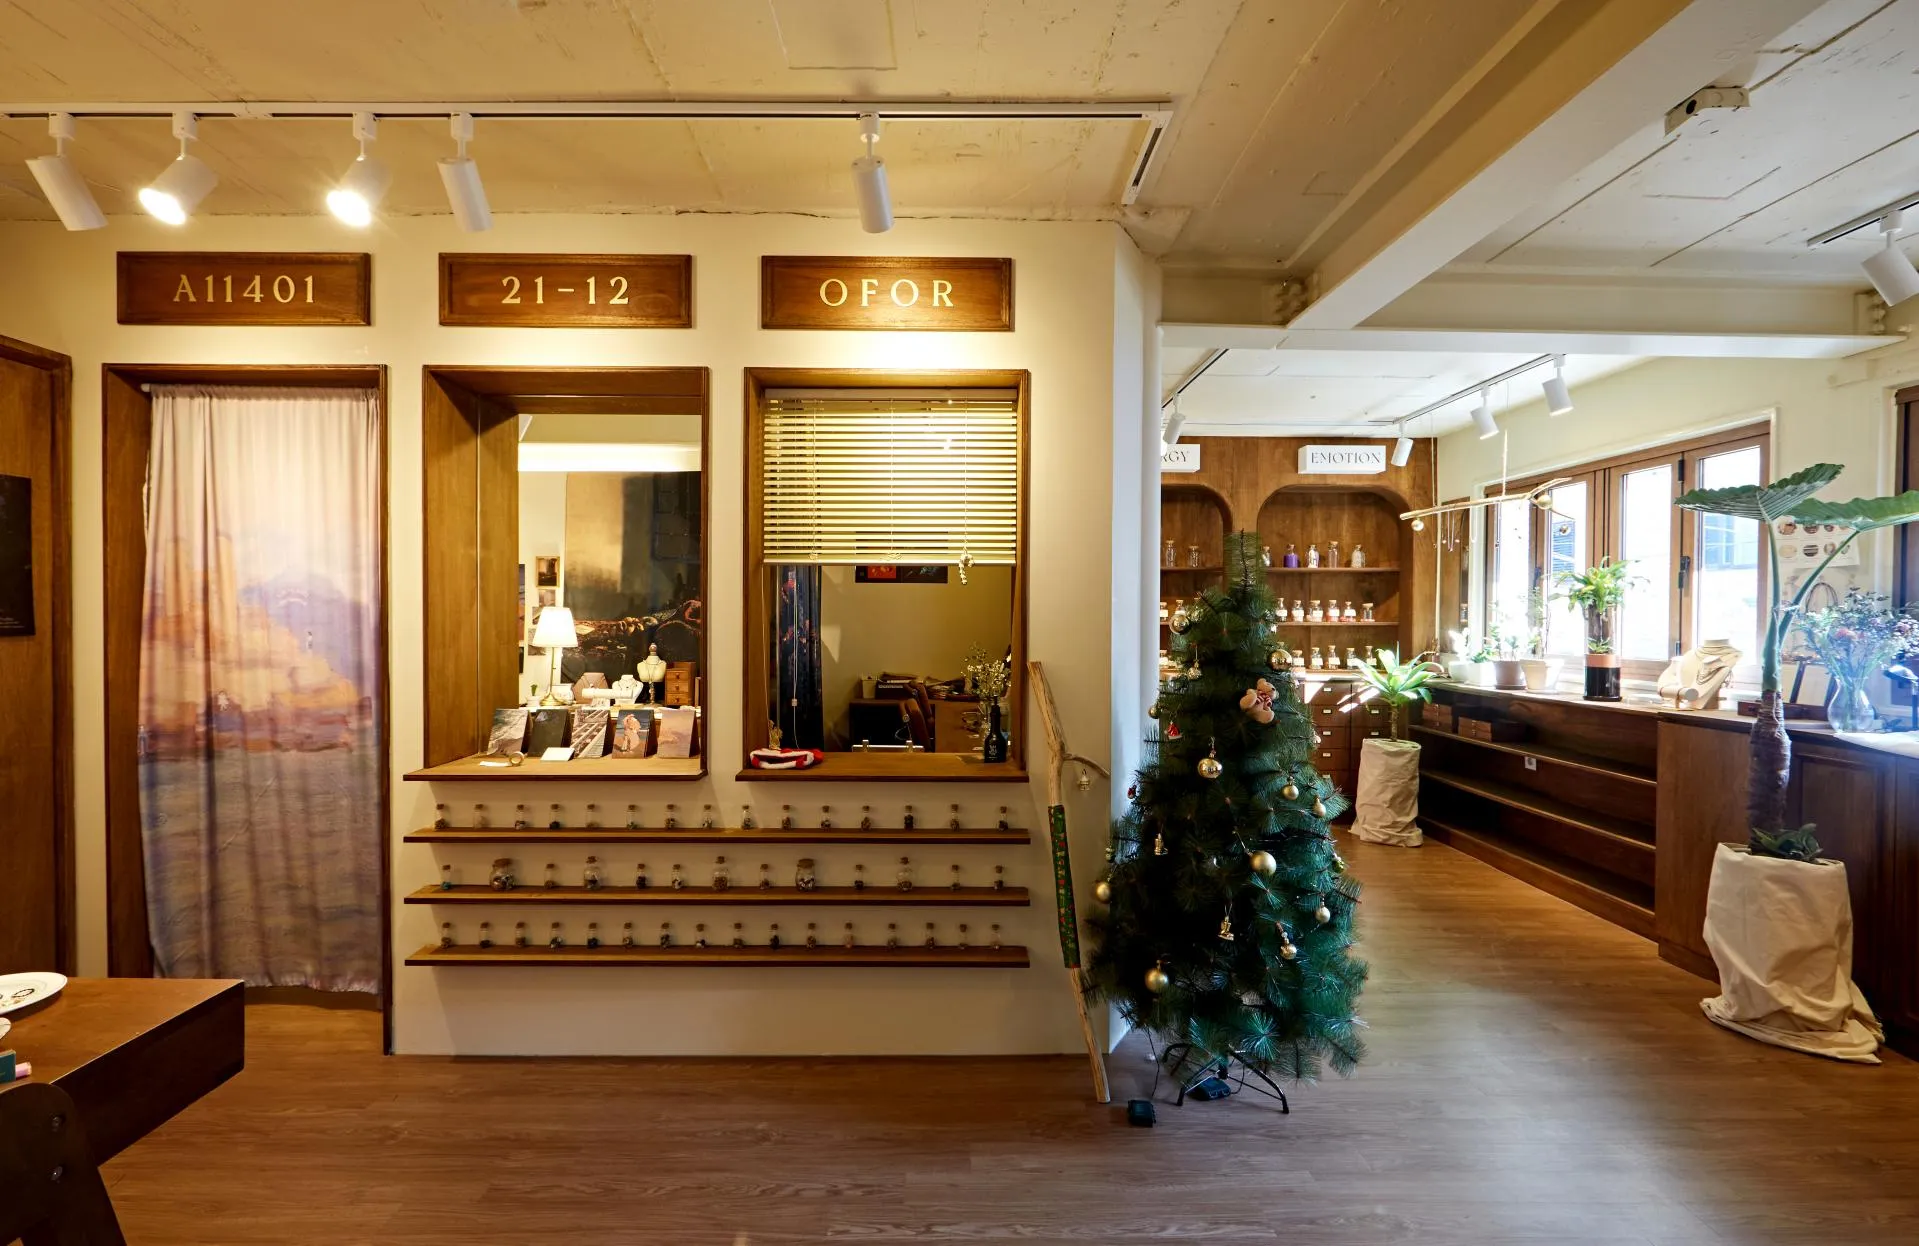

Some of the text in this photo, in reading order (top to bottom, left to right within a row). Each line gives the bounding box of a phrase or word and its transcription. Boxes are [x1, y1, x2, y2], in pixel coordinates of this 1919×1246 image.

[172, 273, 314, 303] A11401
[501, 275, 629, 305] 21-12
[819, 278, 954, 307] OFOR
[1311, 451, 1382, 464] EMOTION
